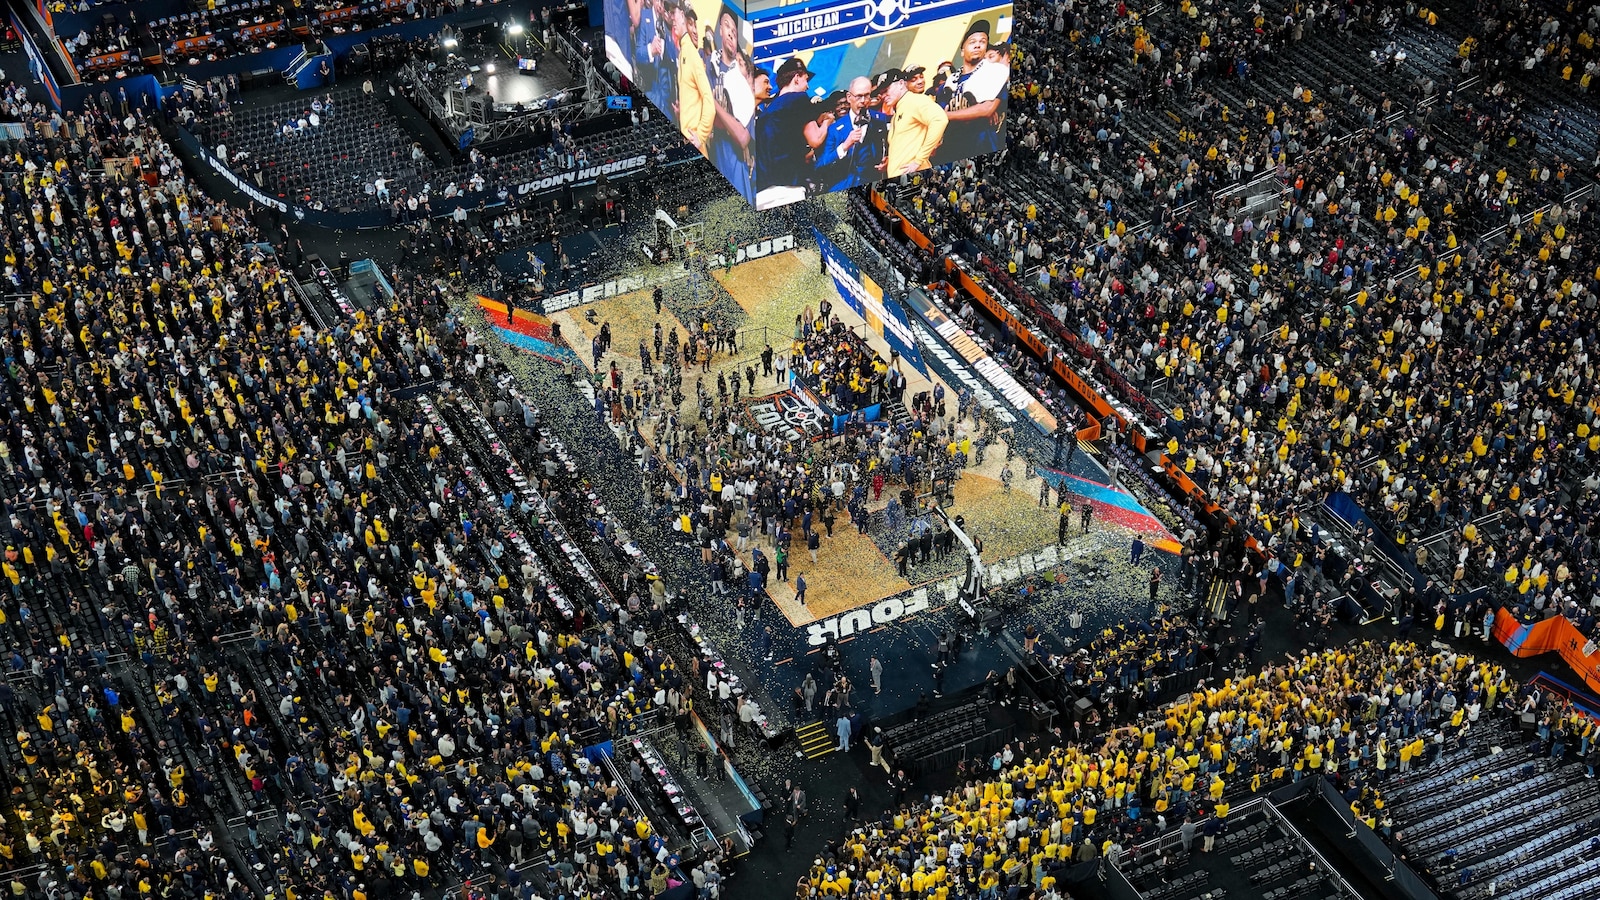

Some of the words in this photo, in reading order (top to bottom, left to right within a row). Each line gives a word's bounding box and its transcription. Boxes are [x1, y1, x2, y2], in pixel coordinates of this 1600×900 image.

[777, 11, 840, 37] MICHIGAN
[209, 156, 239, 188] UCONN
[517, 171, 576, 195] UCONN
[577, 155, 647, 180] HUSKIES
[935, 319, 985, 365] NATIONAL
[973, 356, 1037, 411] CHAMPIONS
[985, 295, 1002, 317] 2026
[1004, 312, 1023, 334] NCAA
[1053, 358, 1075, 384] FINAL
[1077, 380, 1097, 403] FOUR
[807, 588, 929, 646] FOUR
